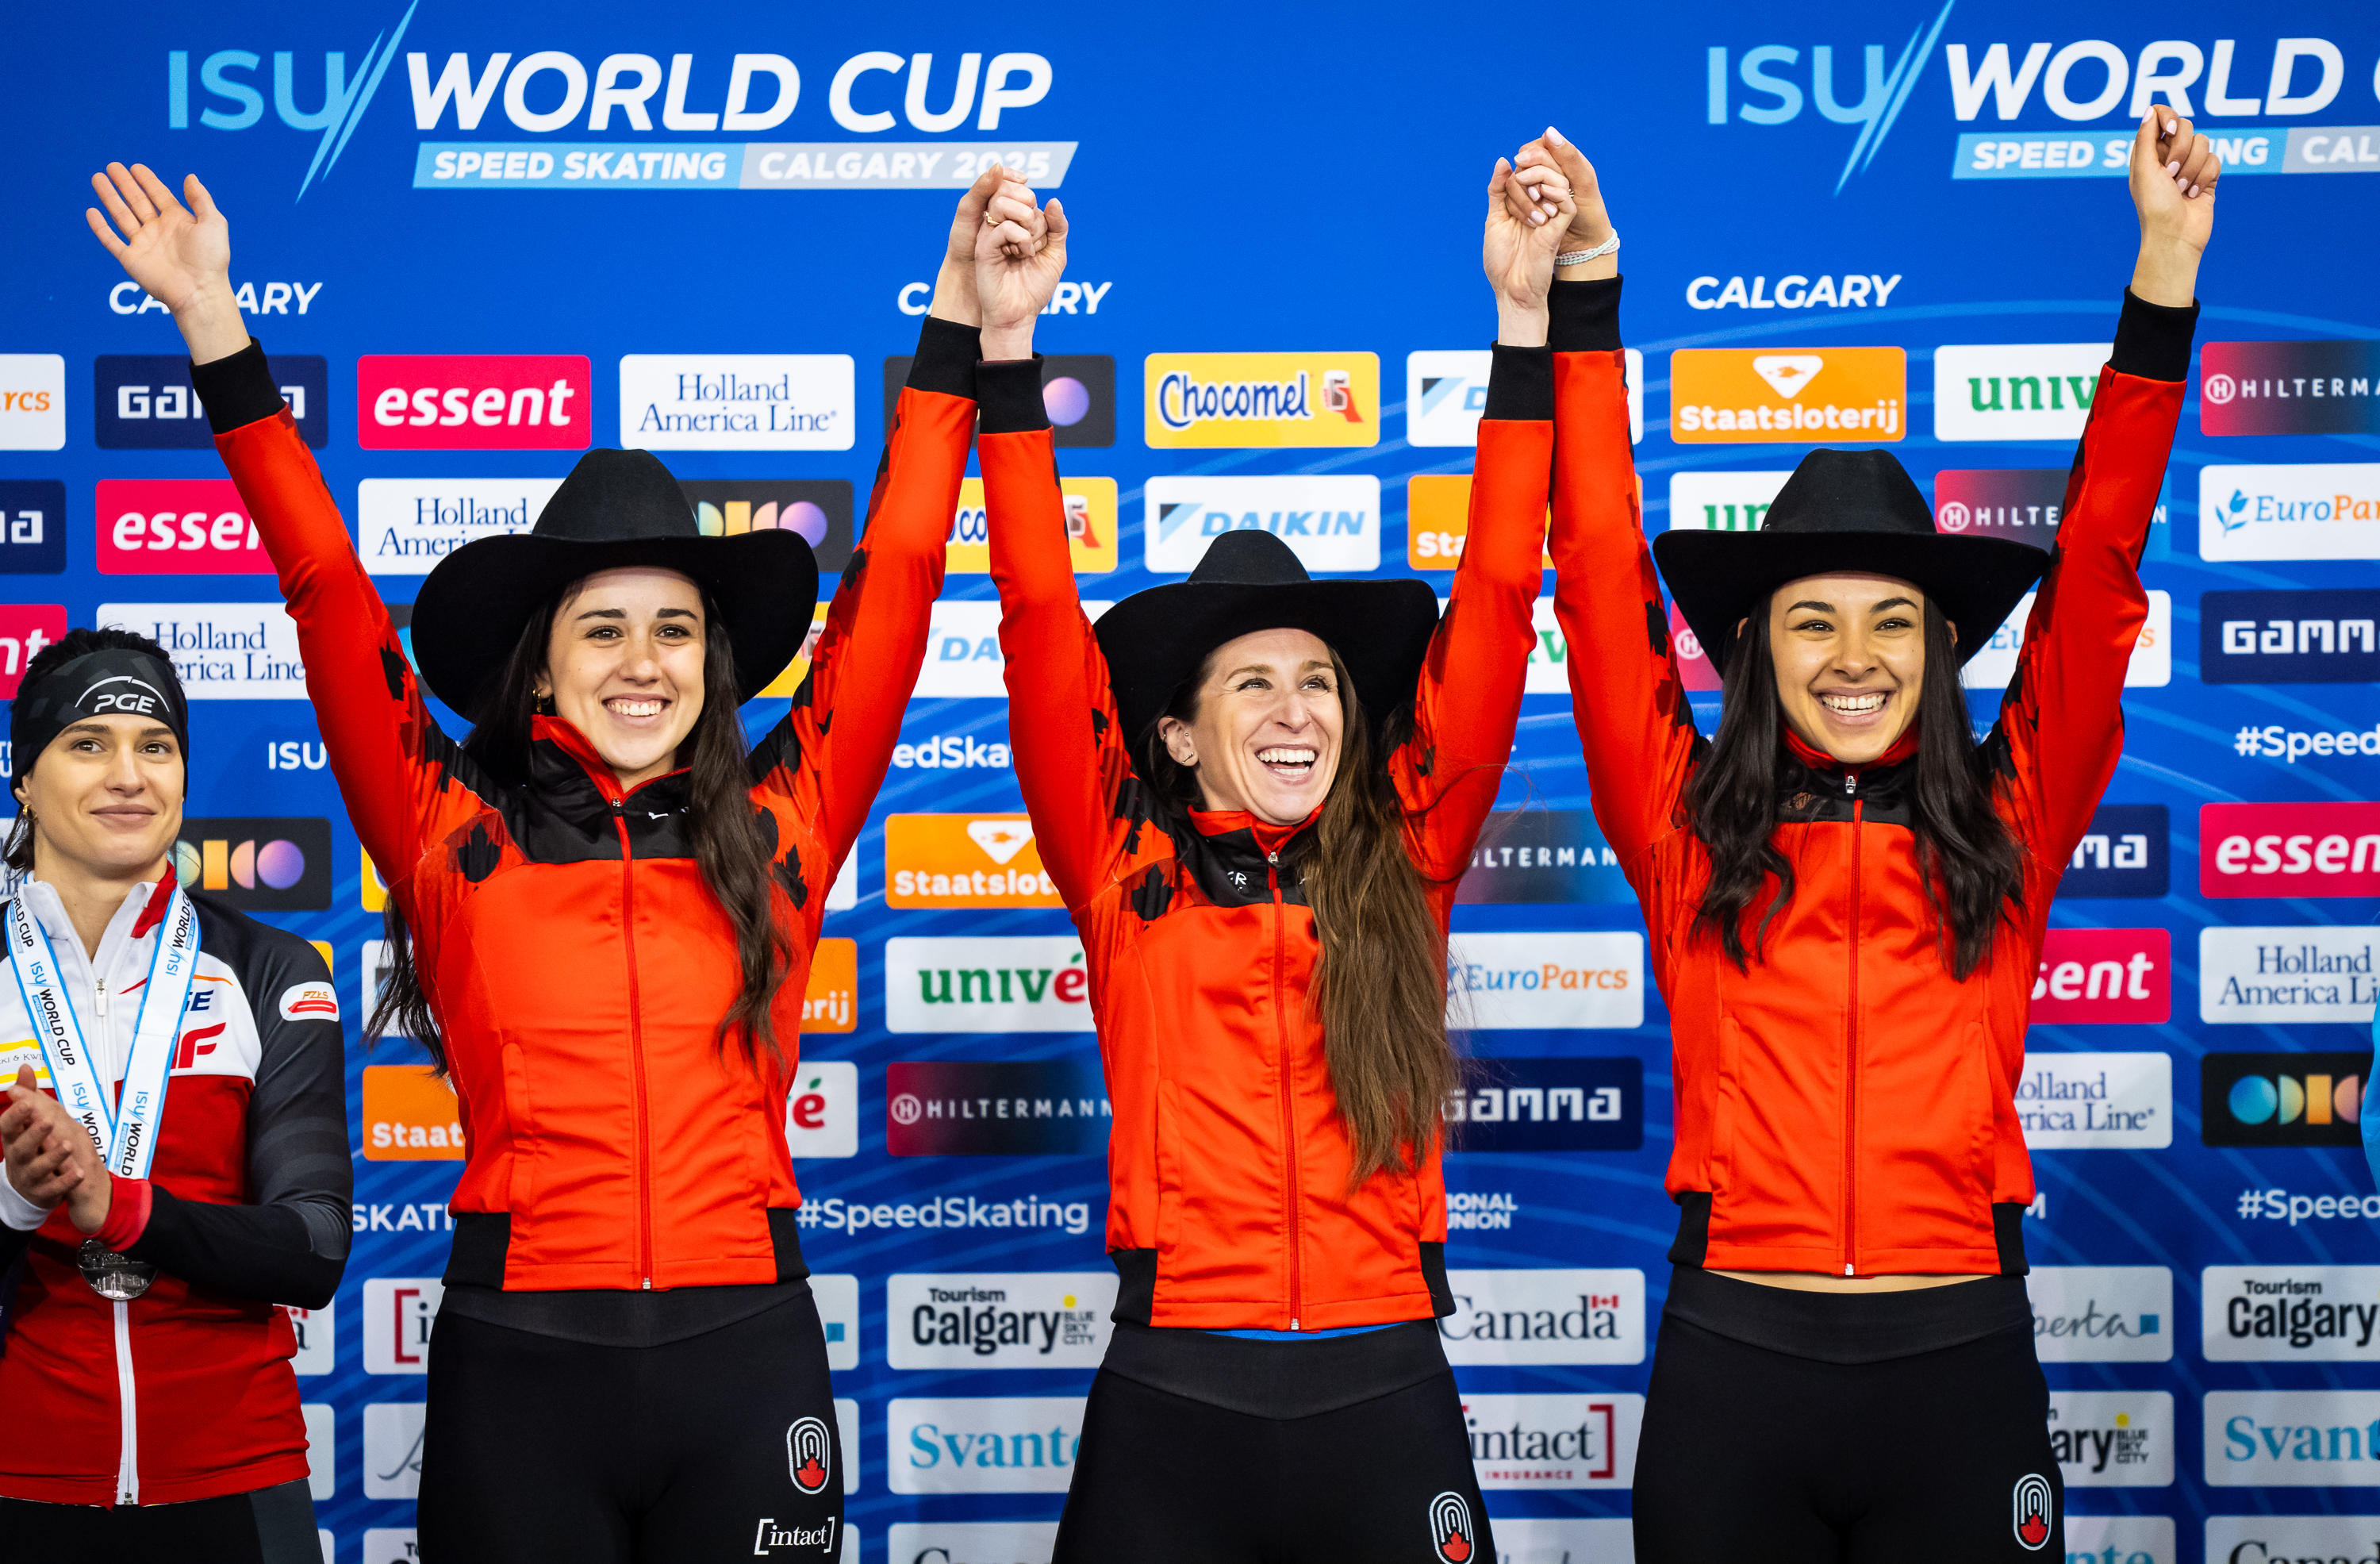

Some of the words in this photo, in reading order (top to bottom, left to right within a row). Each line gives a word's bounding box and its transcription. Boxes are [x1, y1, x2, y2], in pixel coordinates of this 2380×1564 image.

[169, 50, 345, 130] ISU
[407, 51, 800, 132] WORLD
[829, 51, 1053, 133] CUP
[1708, 44, 1884, 125] ISU
[1945, 37, 2344, 121] WORLD
[433, 151, 555, 180] SPEED
[562, 151, 727, 180] SKATING
[758, 151, 942, 180] CALGARY
[1972, 140, 2095, 171] SPEED
[109, 282, 323, 314] CAARY
[1686, 274, 1902, 309] CALGARY
[374, 379, 575, 427] essent
[677, 373, 790, 402] Holland
[1159, 371, 1311, 428] Chocomel
[639, 404, 760, 432] America
[1679, 400, 1898, 433] Staatsloterij
[414, 498, 528, 525] Holland
[1200, 510, 1365, 537] DAIKIN
[153, 621, 267, 650] Holland
[175, 653, 236, 681] erica
[94, 694, 156, 714] PGE
[895, 870, 1061, 897] Staatslot
[19, 922, 34, 947] CUP
[172, 906, 190, 949] WORLD
[2255, 943, 2371, 975] Holland
[919, 951, 1087, 1005] univé
[1465, 963, 1630, 992] EuroParcs
[2218, 975, 2340, 1006] America
[30, 961, 47, 984] ISU
[40, 988, 65, 1036] WORLD
[56, 1039, 75, 1066] CUP
[135, 1091, 149, 1116] ISU
[121, 1123, 143, 1176] WORLD
[795, 1195, 1090, 1236] #SpeedSkating
[928, 1288, 1006, 1303] Tourism
[2244, 1279, 2323, 1296] Tourism
[912, 1304, 1061, 1355] Calgary
[1062, 1312, 1096, 1322] BLUE
[1063, 1323, 1090, 1333] SKY
[1438, 1294, 1622, 1340] Canada
[2228, 1296, 2380, 1347] Calgary
[1063, 1334, 1096, 1346] CITY
